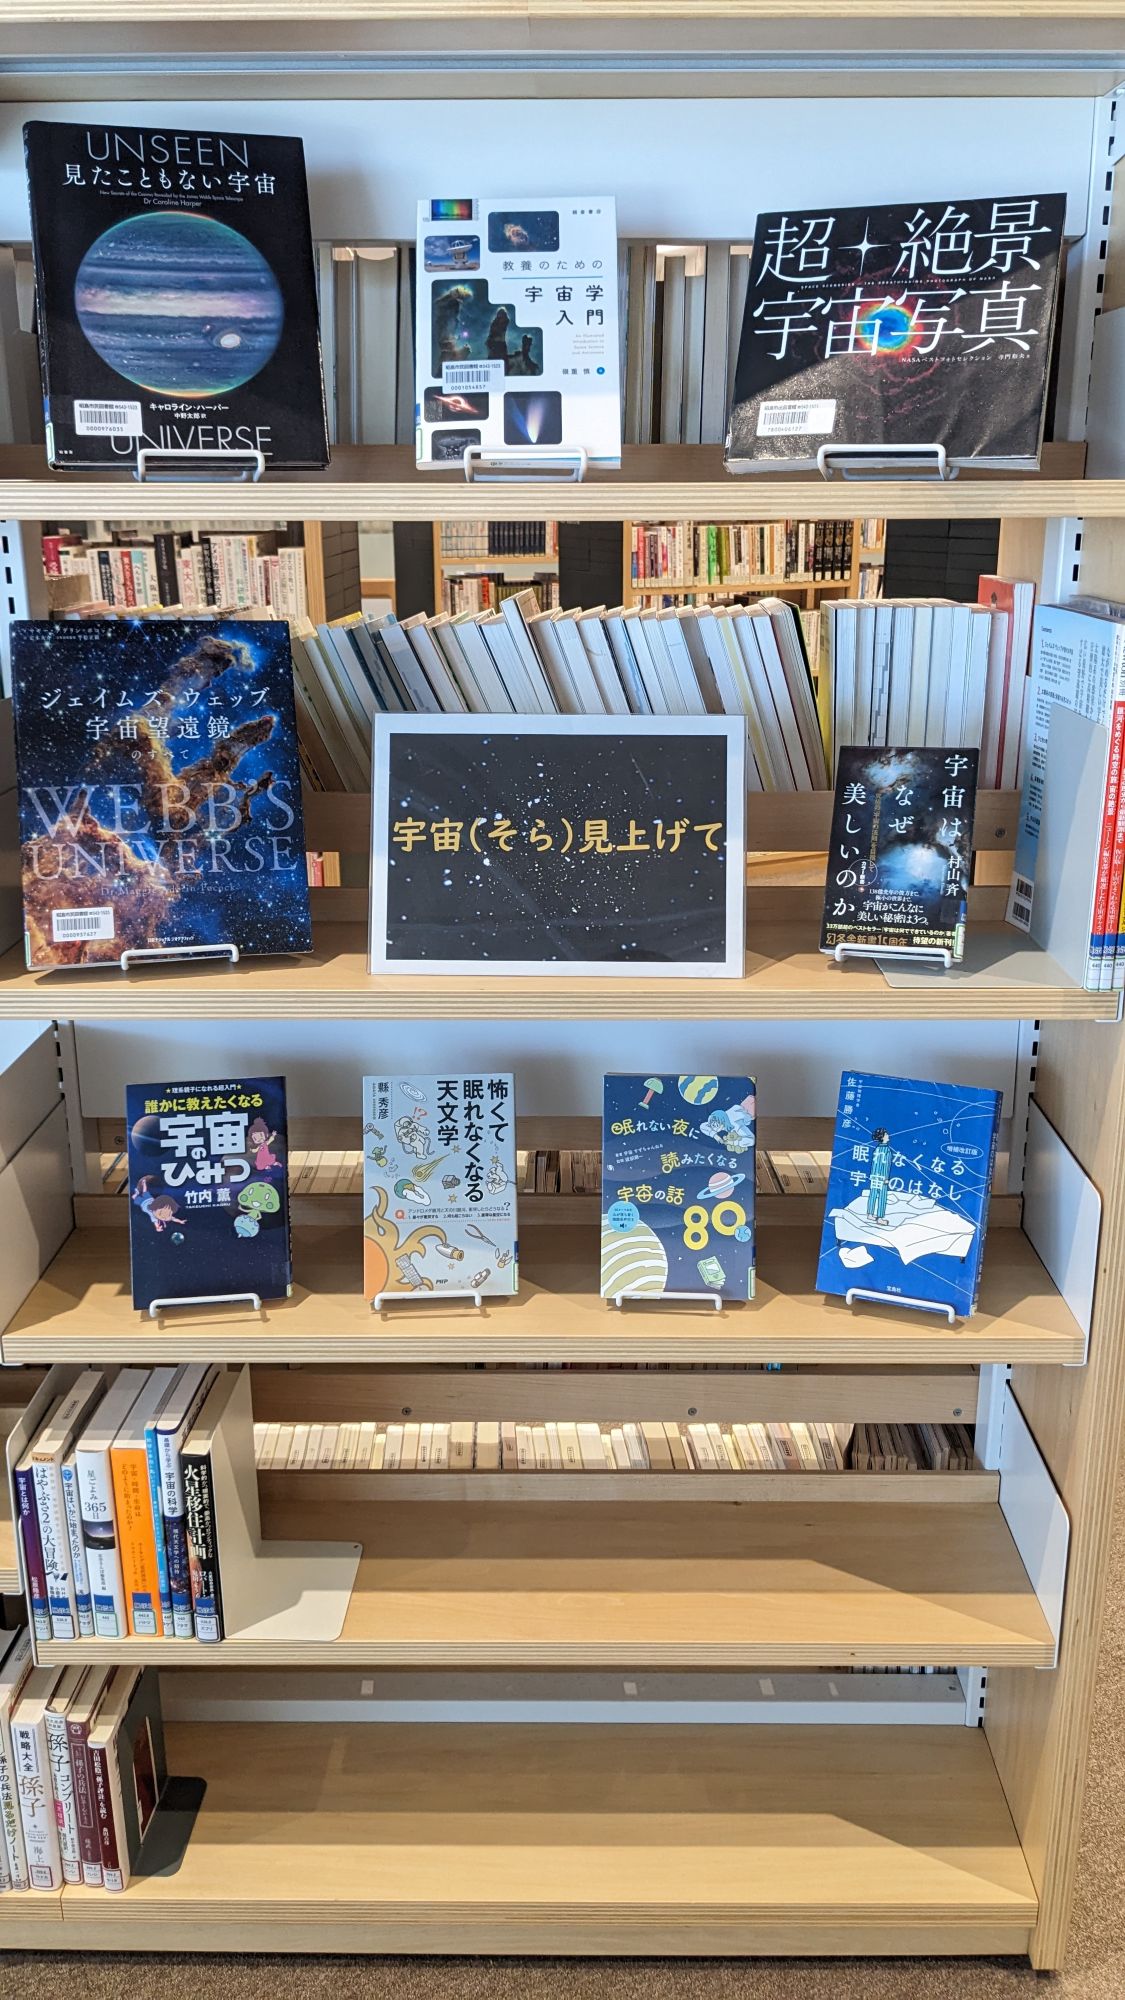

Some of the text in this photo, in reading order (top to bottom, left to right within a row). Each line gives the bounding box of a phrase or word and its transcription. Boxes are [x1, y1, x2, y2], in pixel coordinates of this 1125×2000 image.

[87, 131, 249, 168] UNSEEN
[62, 163, 277, 195] 見たこともない宇宙
[152, 198, 179, 206] Caroline
[180, 199, 202, 207] Harper
[502, 259, 603, 271] 教養のための
[525, 284, 604, 303] 宇宙学
[555, 309, 604, 326] 入門
[753, 280, 1042, 360] 宇宙写真
[149, 402, 229, 411] キャロライン・ハーパー
[110, 424, 273, 455] UNIVERSE
[40, 686, 271, 710] ジェイムズ・ウェッブ
[86, 716, 231, 740] 宇宙望遠鏡
[131, 748, 190, 760] のすべて
[888, 785, 914, 834] なぜ
[941, 754, 968, 838] 宇宙は
[393, 816, 723, 853] 宇宙(そら)見上げて
[832, 782, 867, 916] 美しいのか
[30, 837, 299, 881] UNIVERSE
[857, 910, 929, 926] 美しい秘密は3つ。
[863, 900, 924, 913] 宇宙がこんなに
[144, 1093, 263, 1115] 誰かに教えたくなる
[436, 1080, 459, 1147] 天文学
[487, 1079, 509, 1143] 怖くて
[463, 1079, 484, 1203] 眠れなくなる
[611, 1118, 701, 1141] 眠れない夜に
[161, 1158, 251, 1187] ひみつ
[660, 1152, 738, 1174] 読みたくなる
[852, 1144, 966, 1176] 眠れなくなる
[617, 1184, 685, 1206] 宇宙の話
[850, 1170, 962, 1201] 宇宙のはなし
[683, 1200, 747, 1251] 80
[18, 1477, 30, 1516] 宇宙とは何か
[84, 1501, 107, 1513] 365
[165, 1472, 178, 1515] 宇宙の科学
[35, 1466, 59, 1572] はやぶさ2の大冒険
[65, 1482, 80, 1559] 宇宙はいかに始まったのか
[184, 1464, 207, 1560] 火星移住計画
[19, 1730, 34, 1773] 戦略大全
[18, 1774, 46, 1818] 孫子
[48, 1732, 70, 1773] 孫子
[60, 1774, 76, 1835] コンプリート
